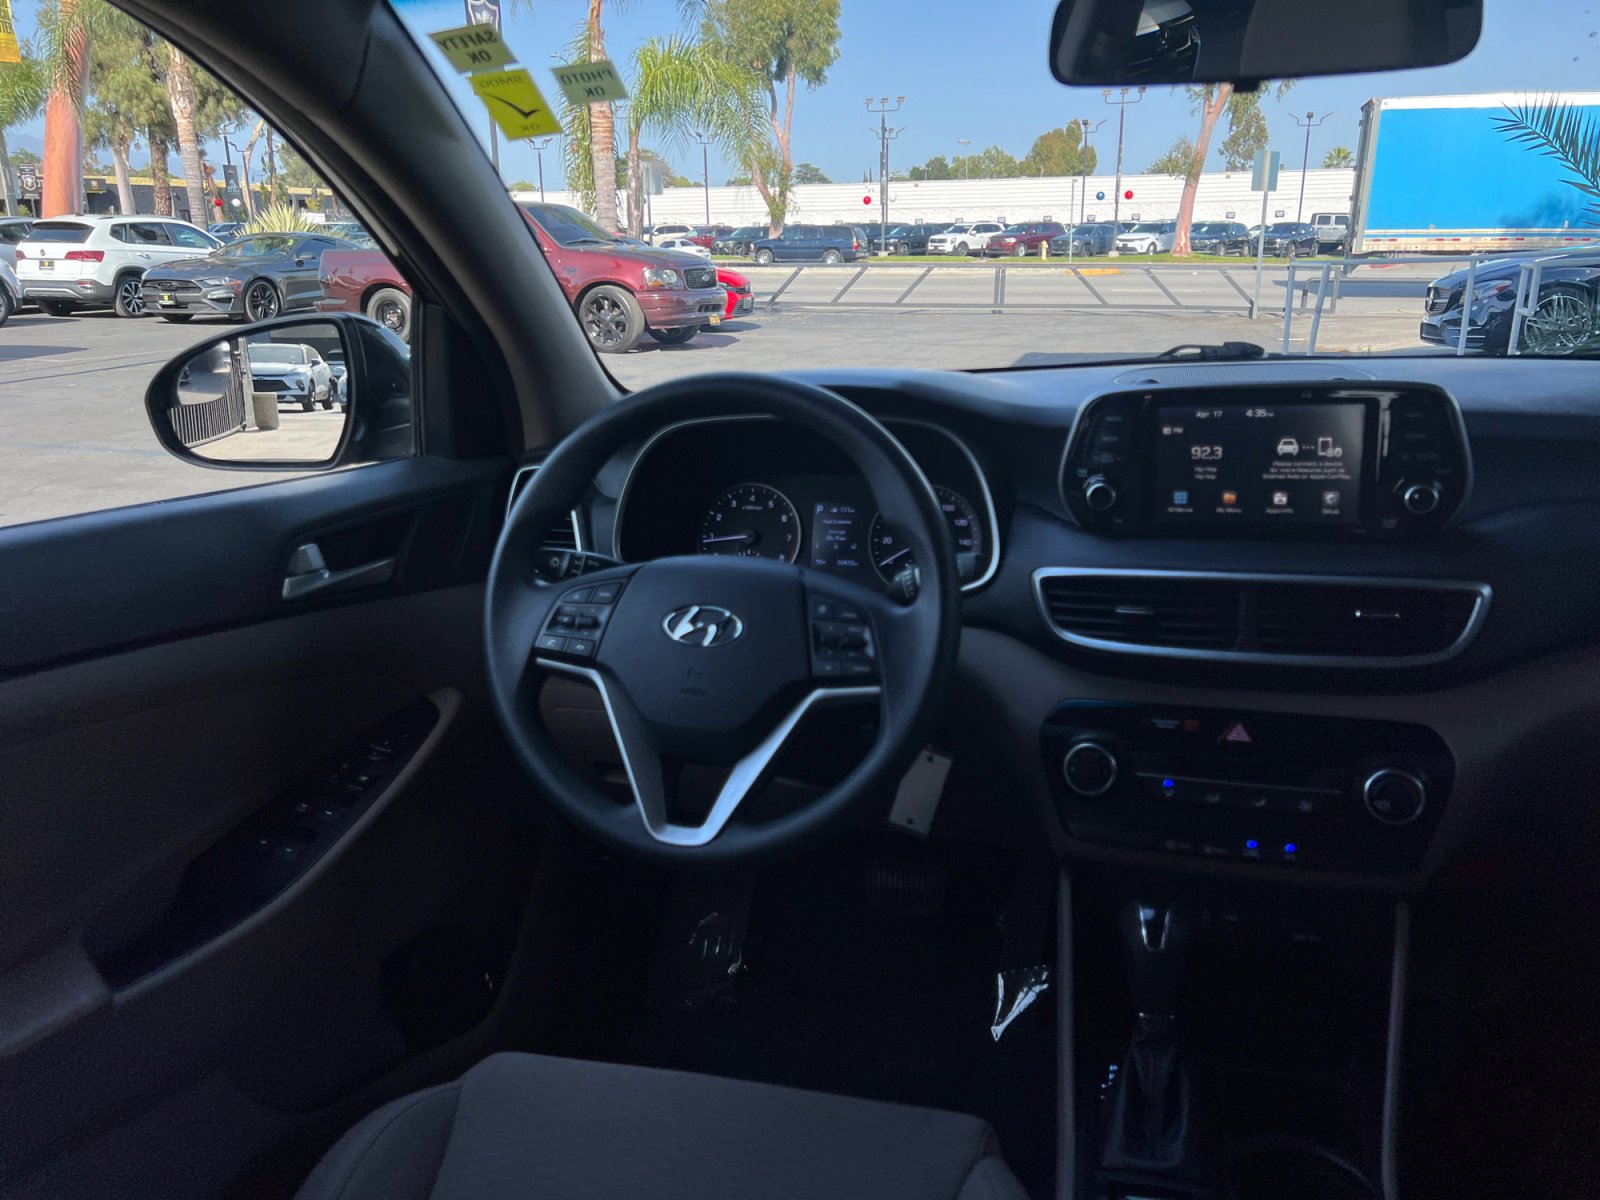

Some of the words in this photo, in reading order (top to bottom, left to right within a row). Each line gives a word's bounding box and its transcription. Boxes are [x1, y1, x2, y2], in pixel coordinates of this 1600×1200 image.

[1191, 446, 1223, 460] 92.3
[731, 500, 737, 508] 3
[768, 500, 774, 509] 5
[816, 505, 824, 514] P
[786, 534, 792, 542] 7
[882, 537, 893, 545] 20
